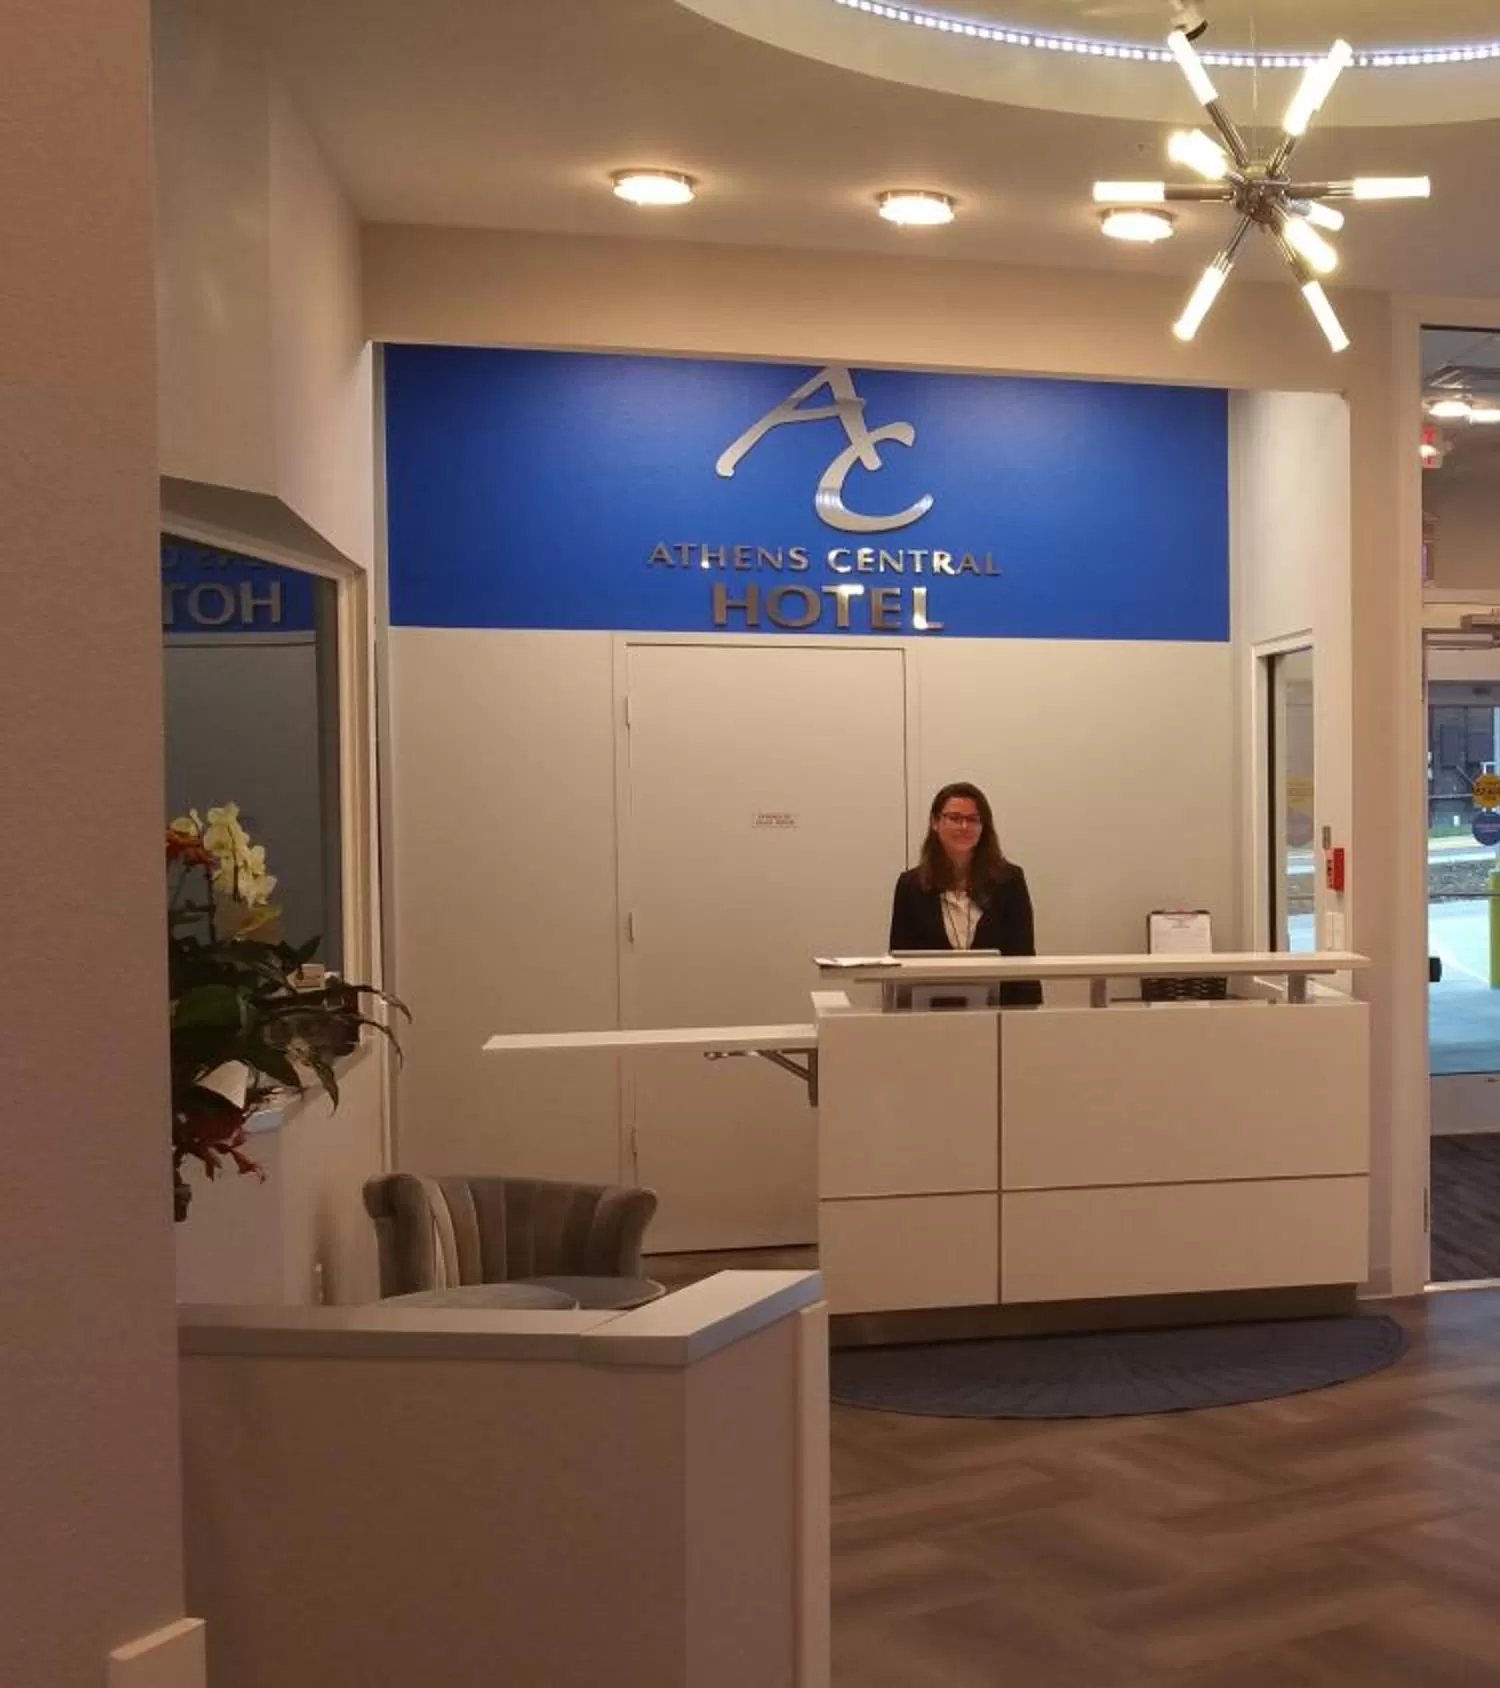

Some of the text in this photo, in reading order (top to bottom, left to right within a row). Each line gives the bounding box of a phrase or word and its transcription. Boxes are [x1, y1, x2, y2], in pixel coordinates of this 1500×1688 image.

[647, 541, 1002, 577] ATHENS CENTRAL
[711, 581, 945, 632] HOTEL
